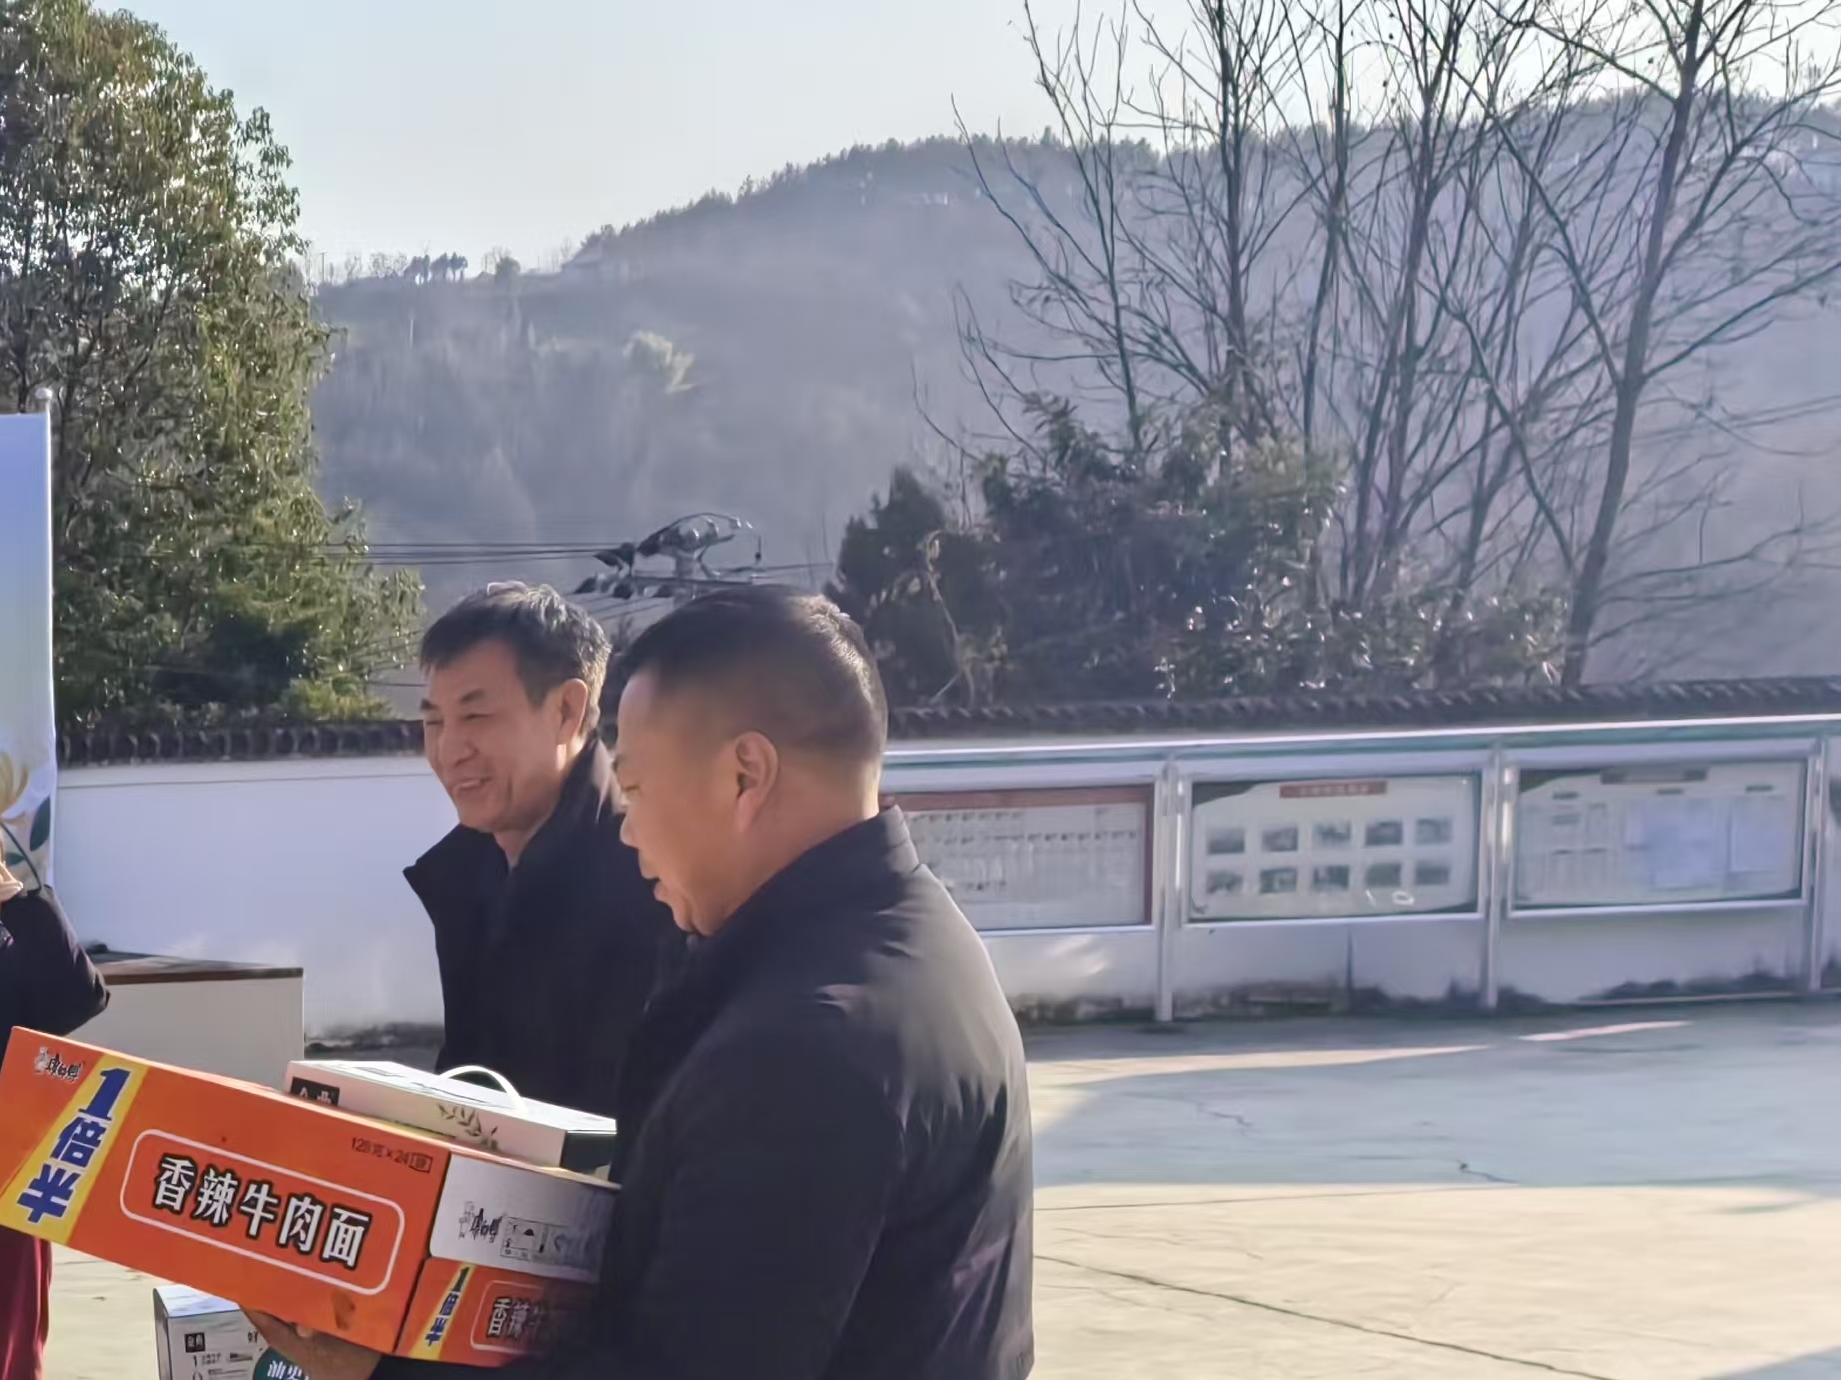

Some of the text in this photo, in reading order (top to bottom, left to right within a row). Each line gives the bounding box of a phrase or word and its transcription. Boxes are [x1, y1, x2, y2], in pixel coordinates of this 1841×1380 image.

[153, 1154, 374, 1270] 香辣牛肉面
